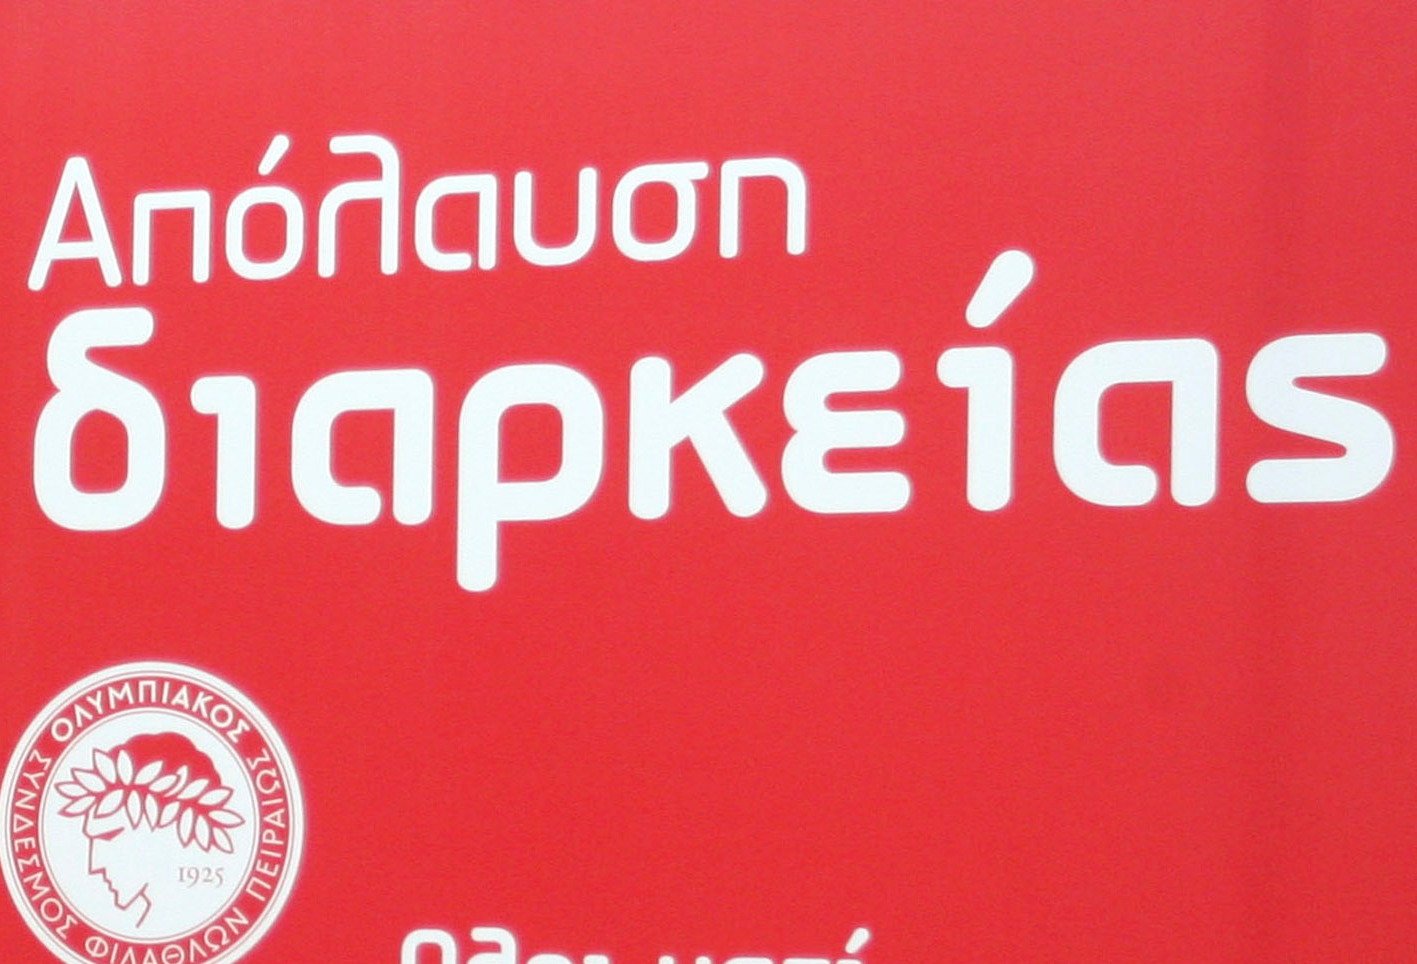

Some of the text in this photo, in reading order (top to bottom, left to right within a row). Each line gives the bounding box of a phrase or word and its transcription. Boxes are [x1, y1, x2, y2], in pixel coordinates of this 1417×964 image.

[27, 133, 808, 292] Απόλαυση
[33, 250, 1396, 593] διαρκείας
[51, 680, 252, 743] ΟΛΥΜΠΙΑΚΟΣ
[13, 751, 77, 939] ΣΥΝΔΕΣΜΟΣ
[177, 866, 224, 889] 1925
[245, 748, 287, 902] ΠΕΙΡΑΙΩΣ
